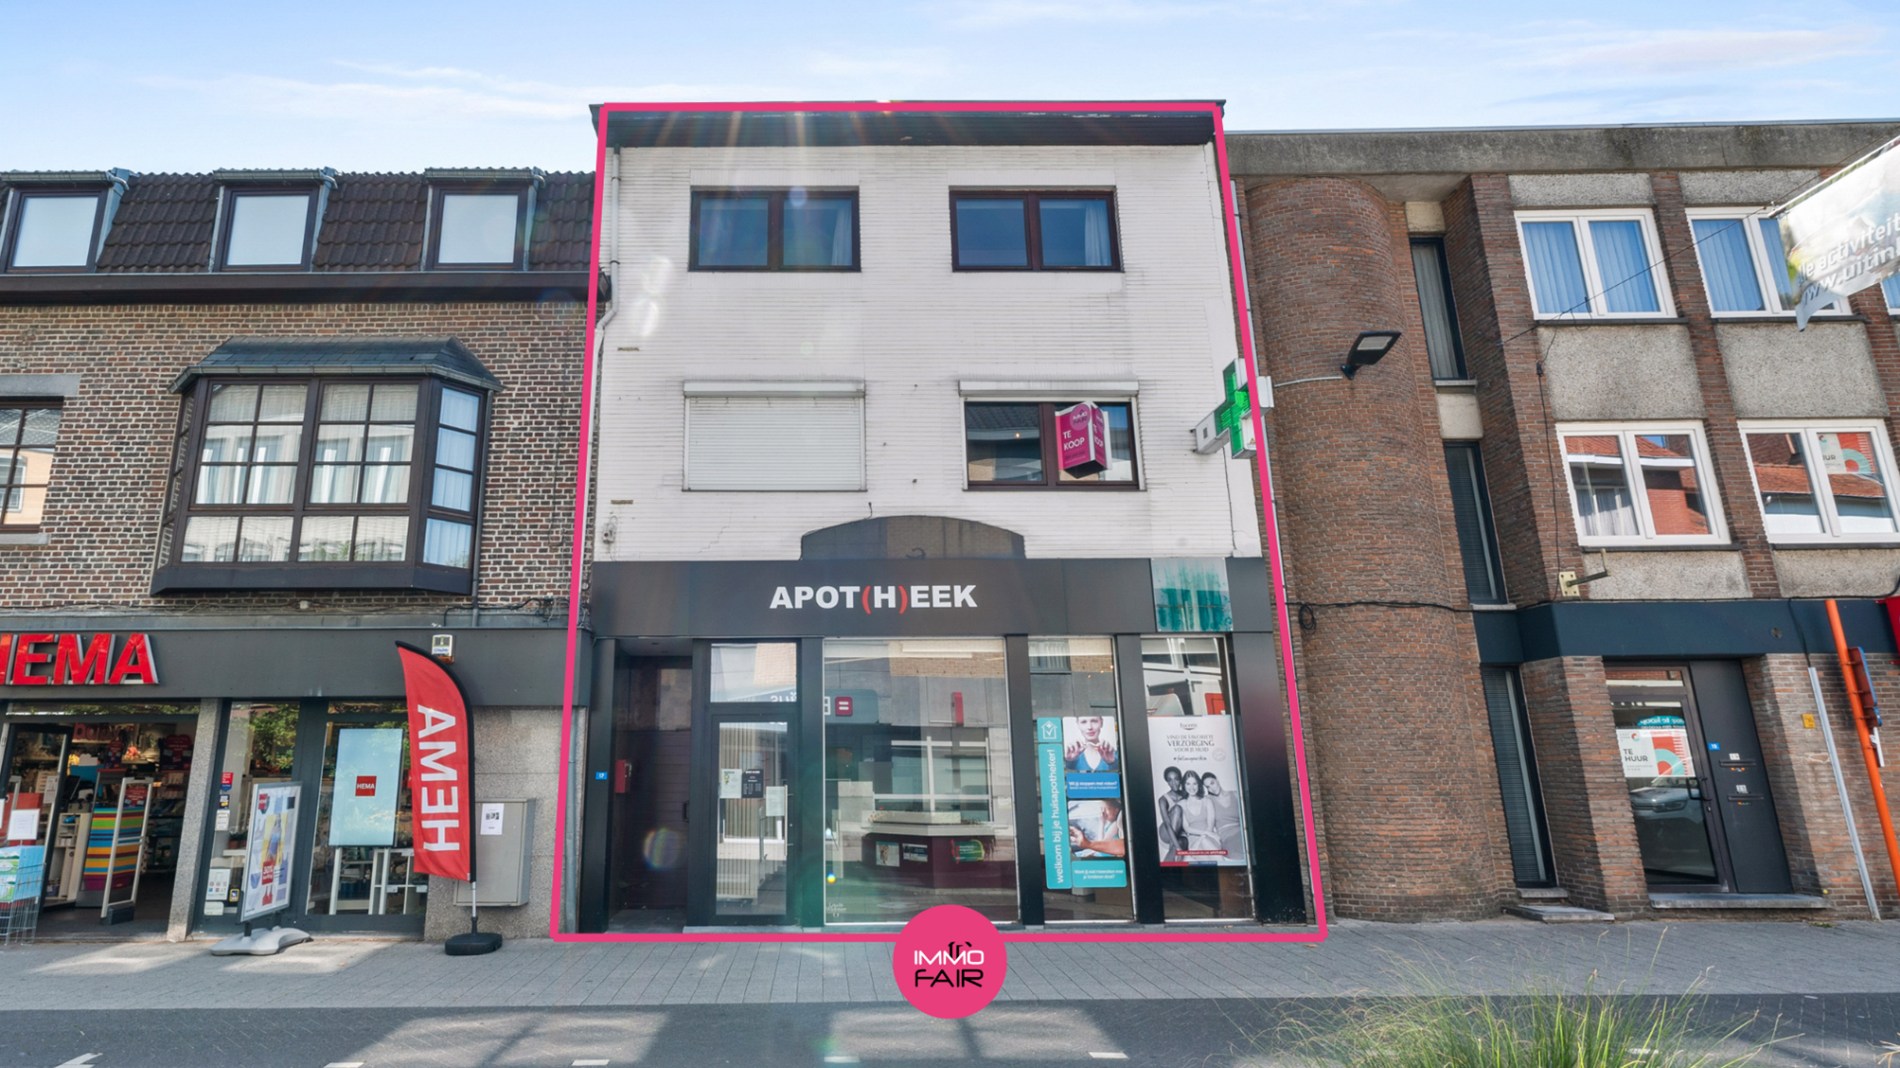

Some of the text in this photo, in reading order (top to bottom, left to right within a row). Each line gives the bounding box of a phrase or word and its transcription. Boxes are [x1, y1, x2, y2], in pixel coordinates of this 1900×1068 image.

[1063, 430, 1072, 439] TE
[1064, 437, 1084, 450] KOOP
[769, 584, 978, 615] APOT(H)EEK
[1048, 750, 1064, 884] welkom bij je huisapotheker!
